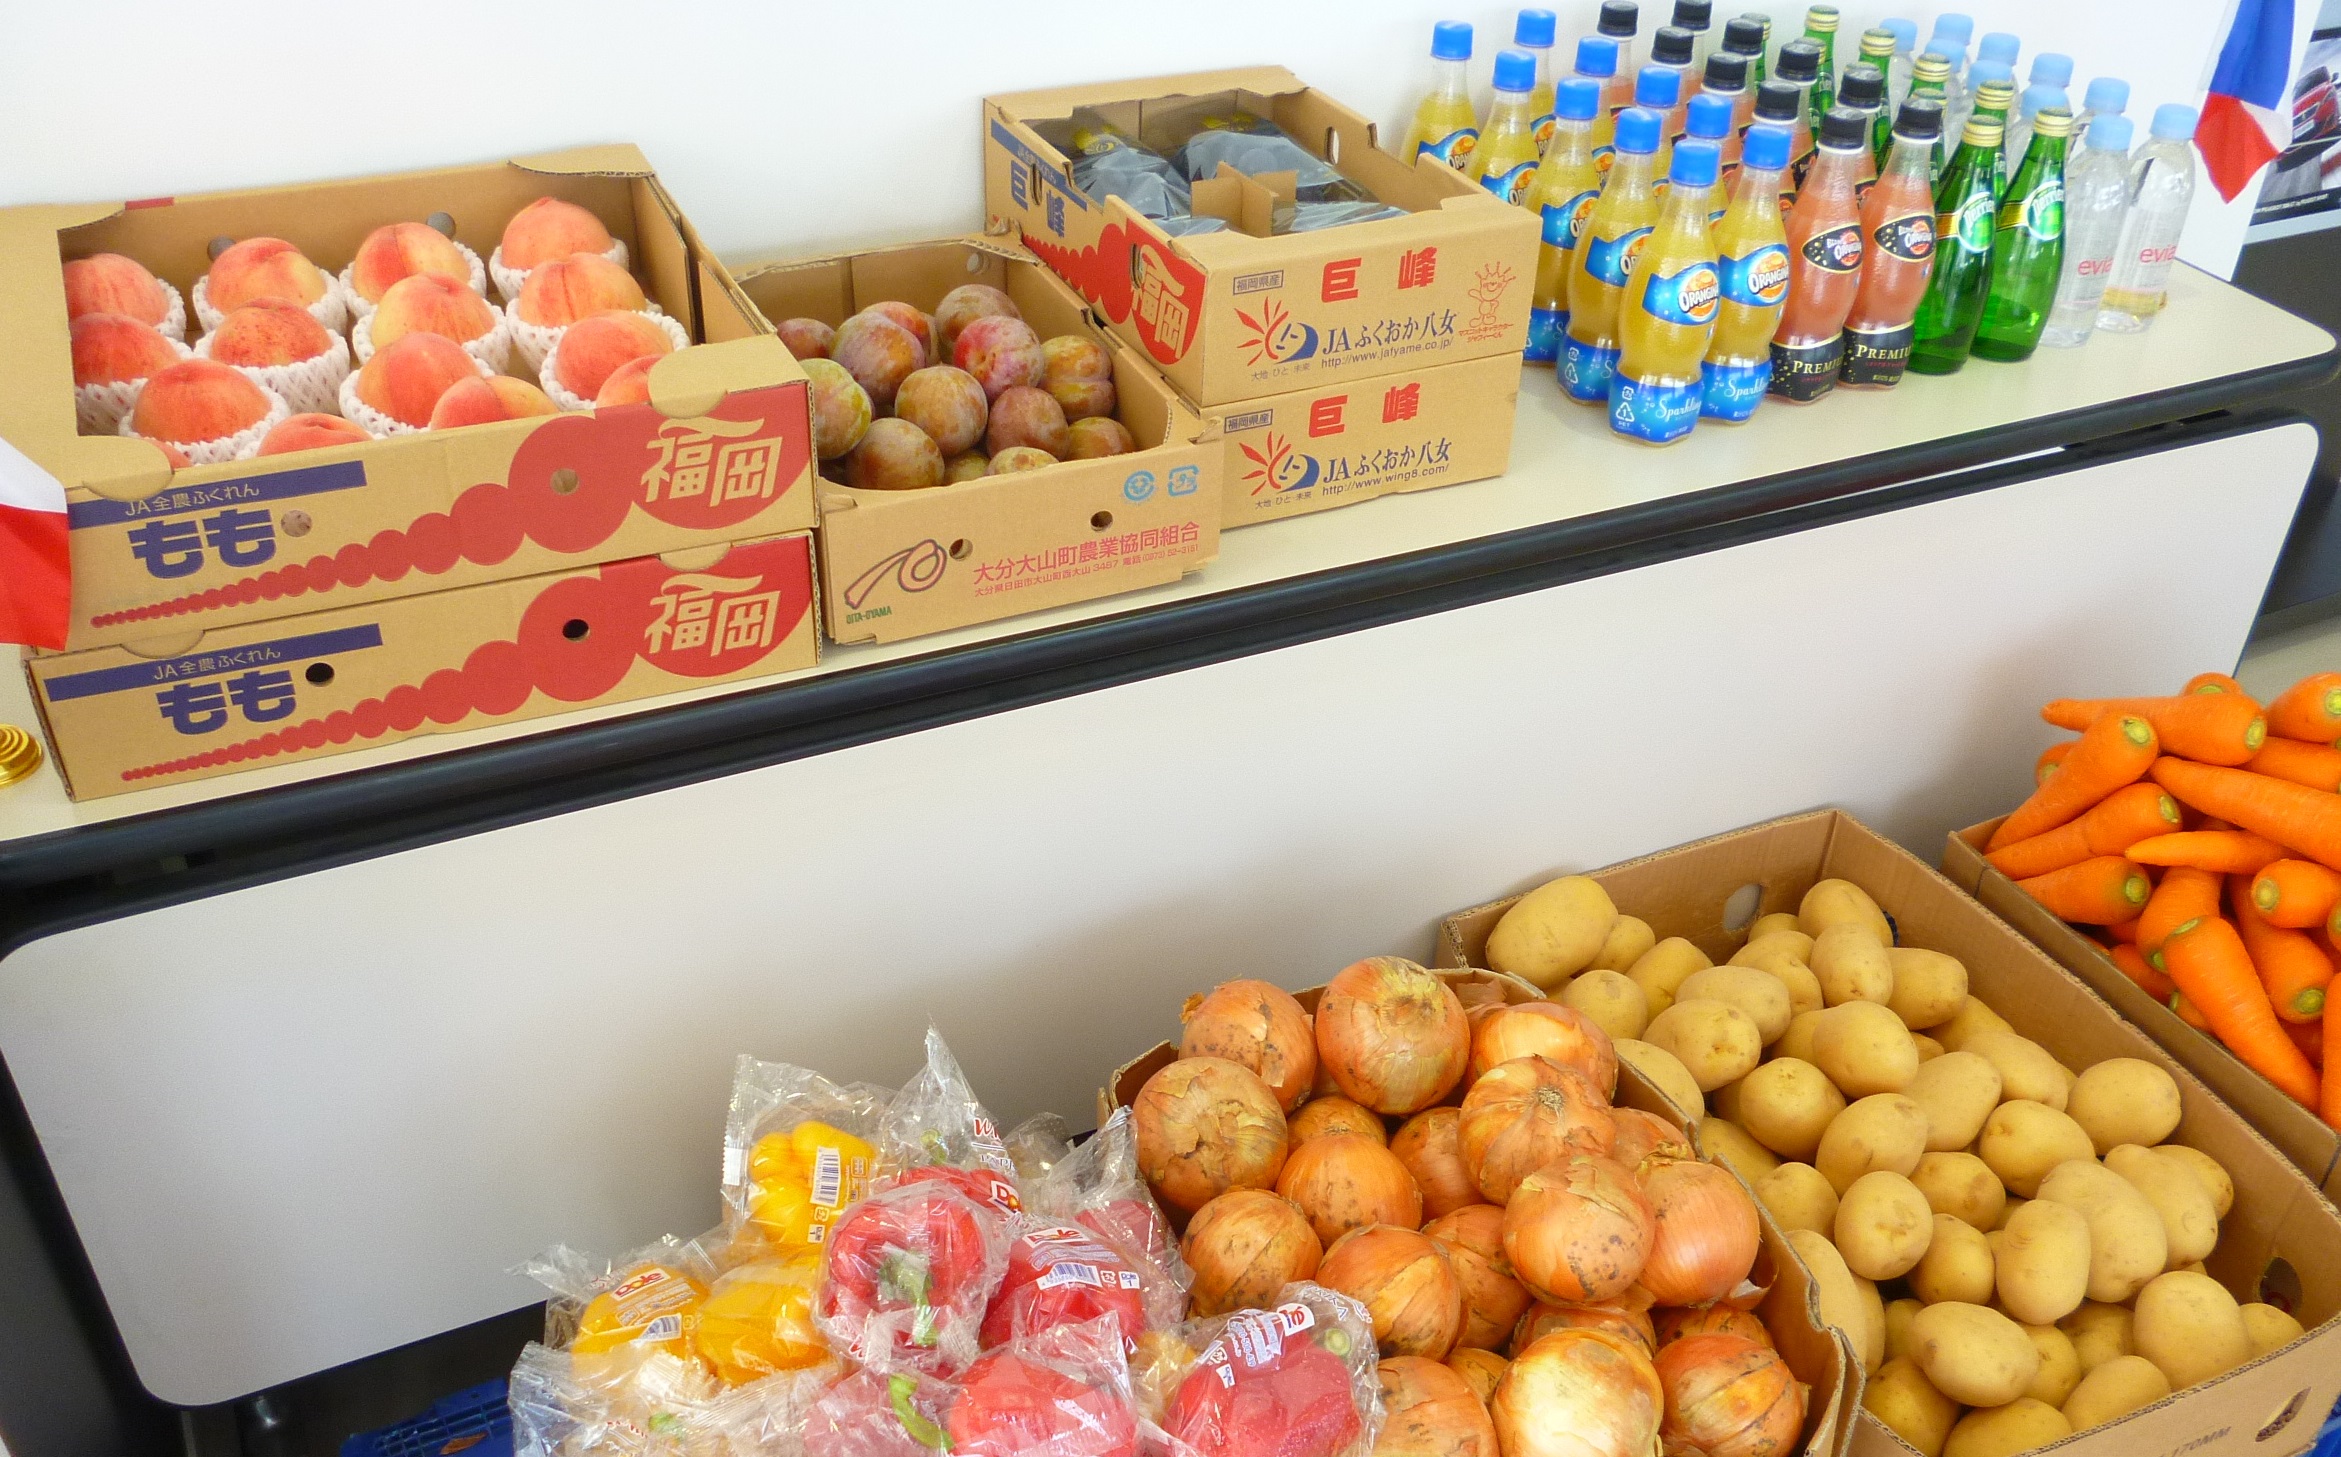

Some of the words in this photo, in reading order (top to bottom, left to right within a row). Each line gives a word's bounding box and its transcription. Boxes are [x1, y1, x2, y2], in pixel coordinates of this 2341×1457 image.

[2078, 256, 2114, 275] evia
[2140, 244, 2177, 263] evia
[1236, 274, 1281, 291] 福岡県産
[1321, 246, 1438, 303] 巨峰
[1321, 337, 1455, 369] http://www.jafyame.co.jp/
[1792, 354, 1843, 374] PREMIU
[1856, 344, 1913, 360] PREMIU
[1227, 412, 1270, 430] 福岡県産
[1308, 382, 1421, 438] 巨峰
[641, 416, 783, 507] 福岡
[1321, 463, 1450, 496] http://www.wing8.com/
[127, 509, 277, 579] もも
[973, 521, 1200, 585] 大分大山町農業協同組合
[644, 573, 781, 657] 福岡
[155, 670, 297, 735] もも
